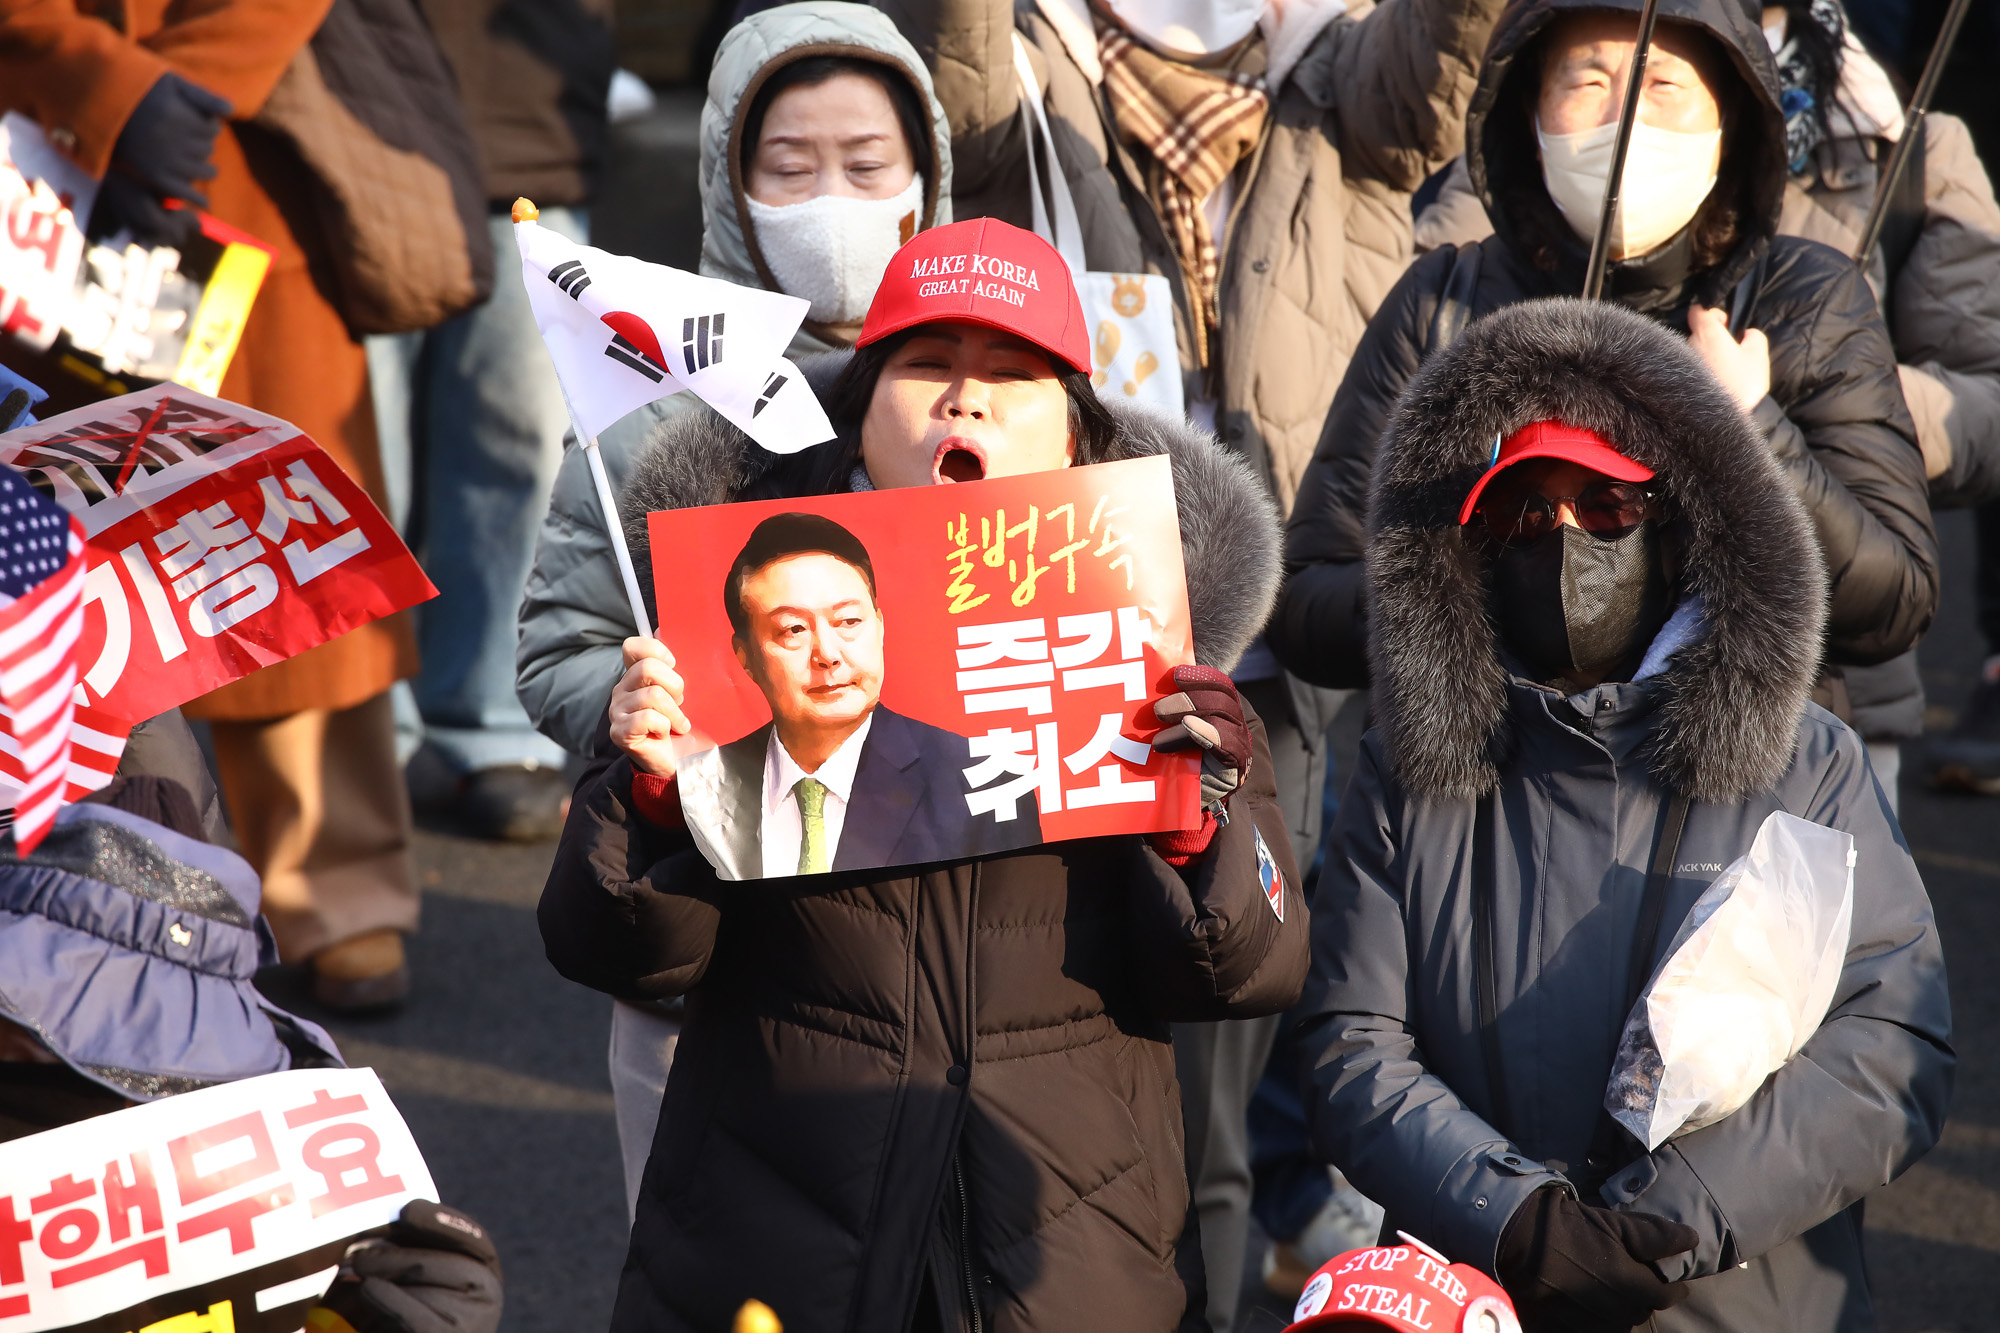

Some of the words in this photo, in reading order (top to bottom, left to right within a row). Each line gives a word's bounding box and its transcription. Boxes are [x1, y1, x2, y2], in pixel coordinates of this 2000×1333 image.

[910, 254, 967, 279] MAKE
[970, 254, 1041, 291] KOREA
[918, 279, 970, 298] GREAT
[972, 280, 1026, 308] AGAIN
[74, 458, 372, 707] 기총선
[955, 605, 1154, 716] 즉각
[961, 712, 1157, 823] 취소
[1674, 863, 1699, 872] ACK
[1700, 863, 1722, 872] YAK
[1336, 1248, 1410, 1275] STOP
[1414, 1254, 1468, 1307] THE
[1338, 1283, 1433, 1330] STEAL
